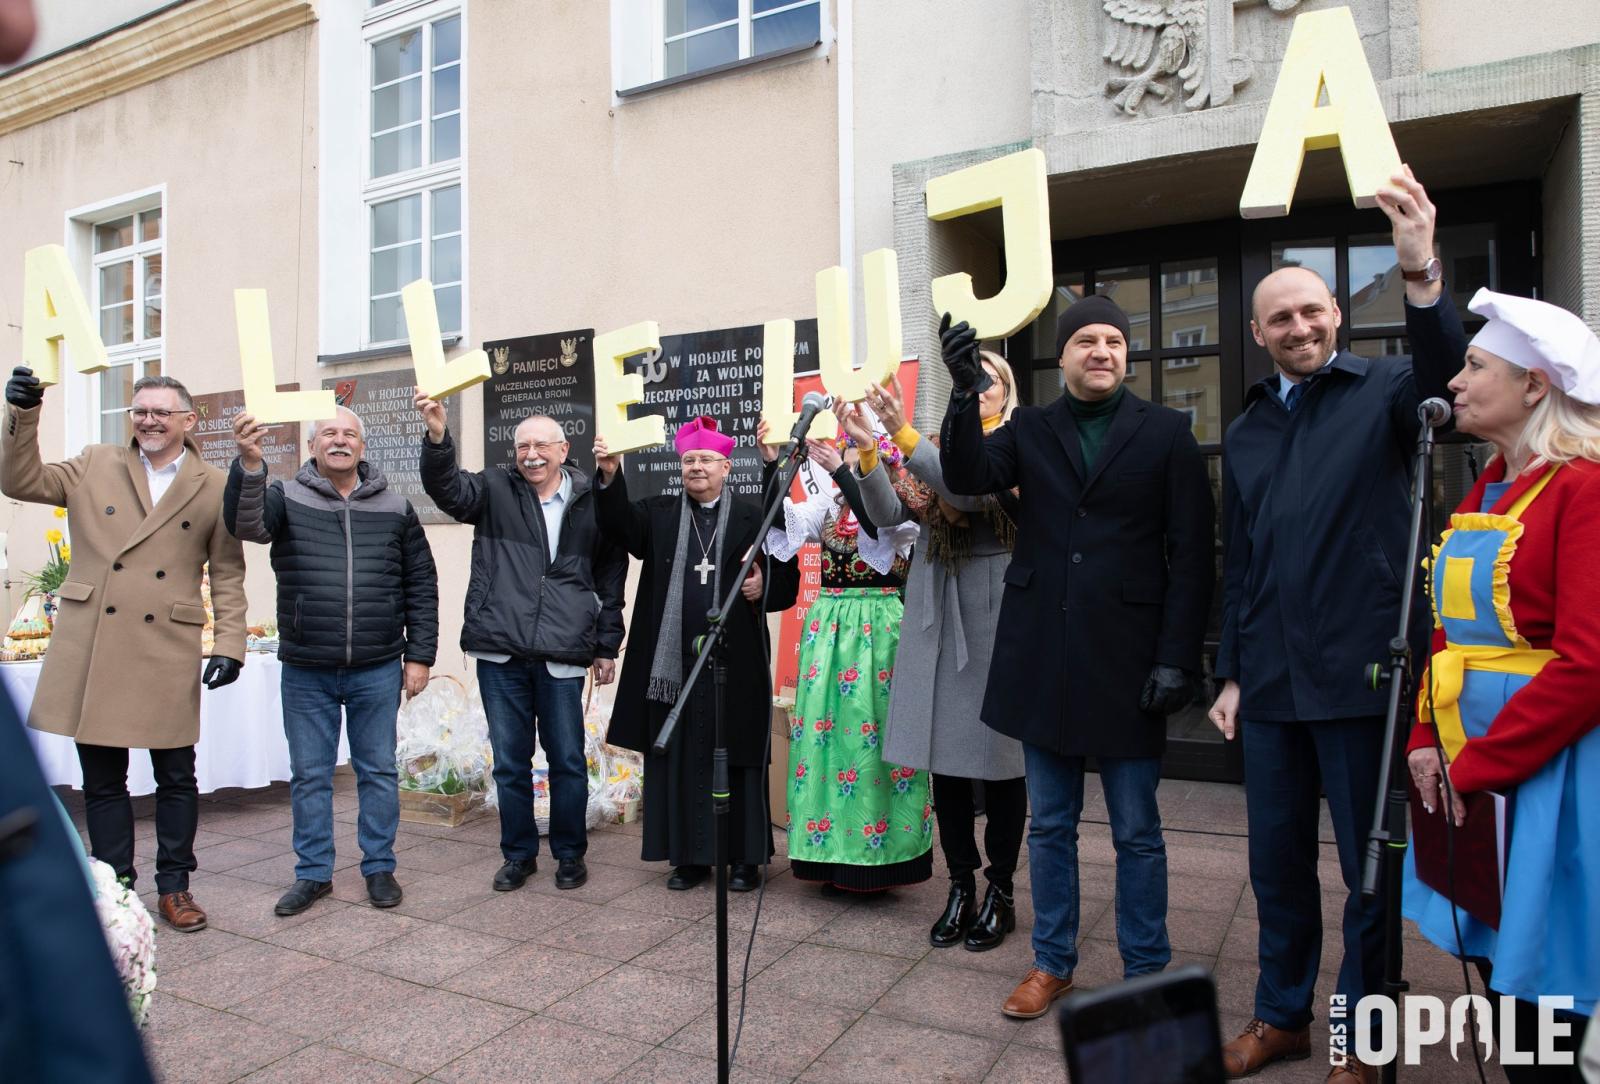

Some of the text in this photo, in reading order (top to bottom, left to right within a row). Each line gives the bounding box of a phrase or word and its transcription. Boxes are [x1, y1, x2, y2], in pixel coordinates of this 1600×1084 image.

[512, 357, 558, 374] PAMIĘCI
[669, 355, 681, 369] W
[688, 349, 737, 367] HOŁDZIE
[696, 364, 763, 383] ZA WOLNO
[494, 376, 578, 393] NACZELNEGO WODZA
[368, 391, 376, 401] W
[501, 389, 571, 403] GENERAŁA BRONI
[393, 411, 424, 423] "SKOR
[500, 403, 573, 420] WŁADYSŁAWA
[666, 400, 762, 419] W LATACH 193
[208, 418, 234, 431] SUDEC
[363, 423, 429, 438] OCZNICĘ BITW
[638, 463, 646, 472] W
